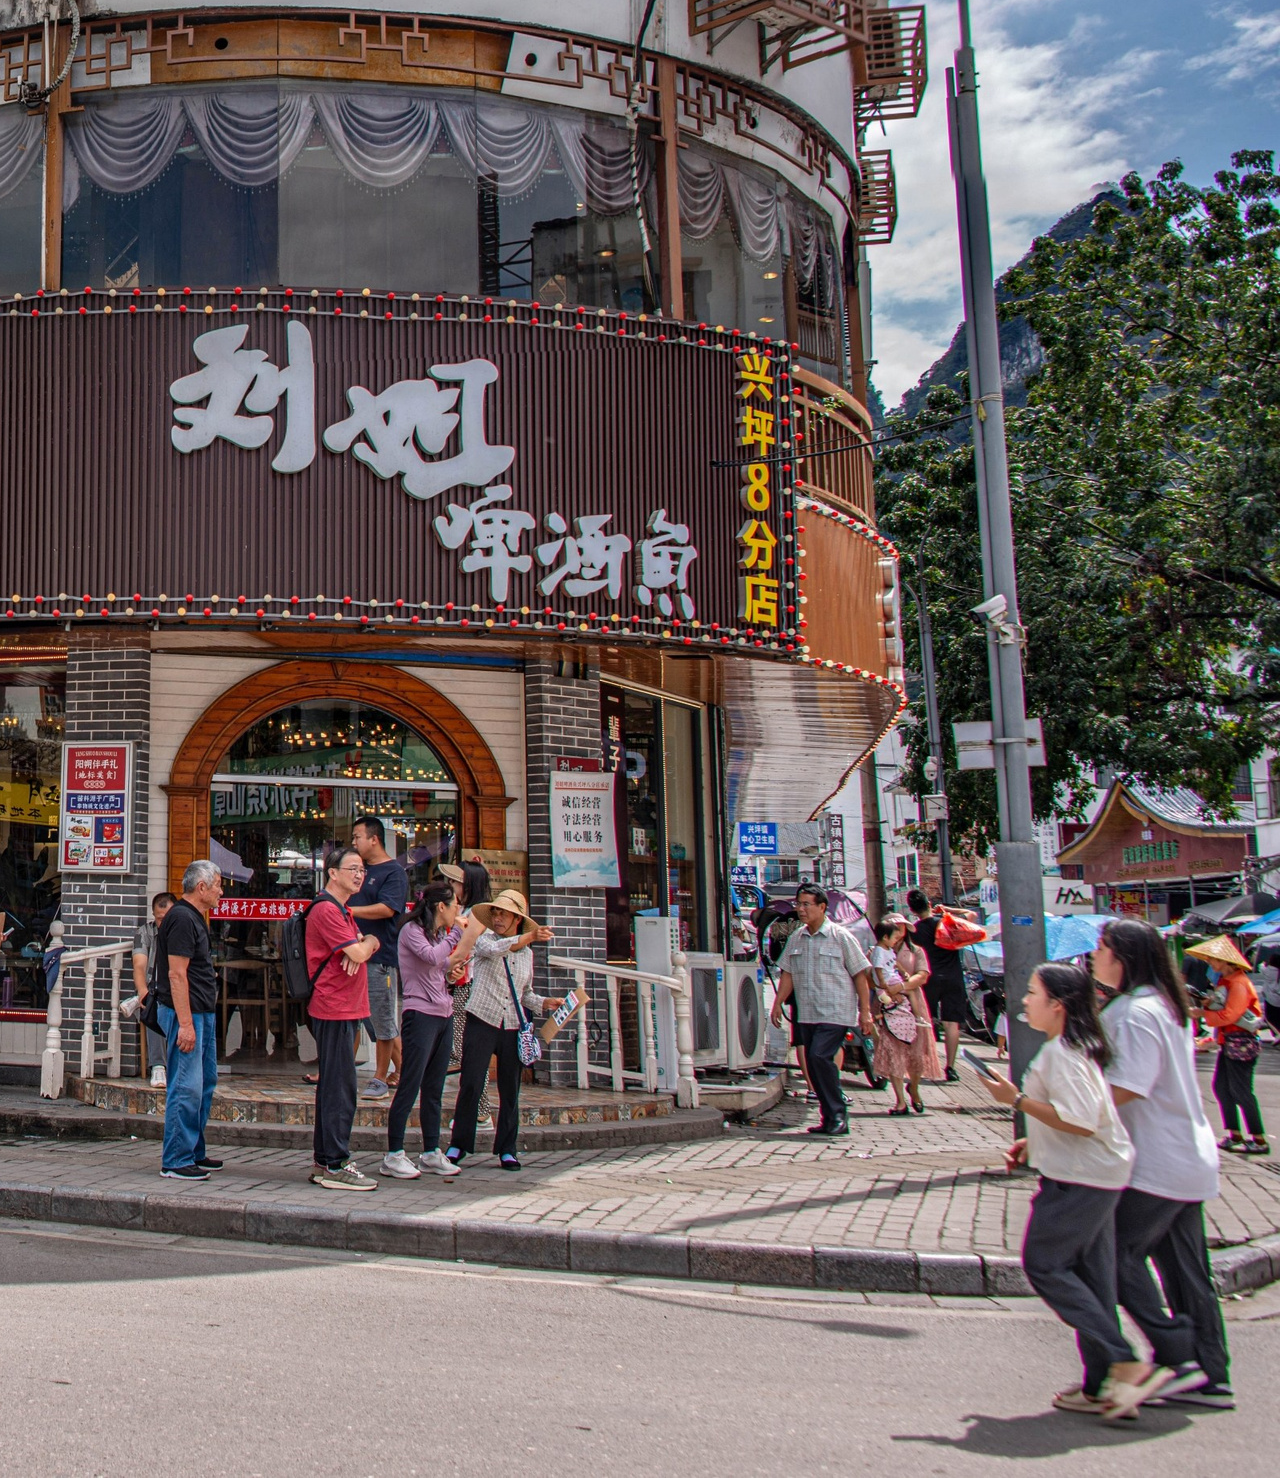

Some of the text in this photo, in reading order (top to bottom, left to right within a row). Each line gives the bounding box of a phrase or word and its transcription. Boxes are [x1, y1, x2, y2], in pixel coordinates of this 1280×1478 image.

[735, 351, 779, 629] 兴坪8分店
[433, 482, 698, 621] 啤酒鱼
[75, 759, 118, 770] 阳朔伴手礼
[562, 813, 602, 827] 守法经营
[747, 825, 768, 834] 兴坪镇
[563, 830, 603, 844] 用心服务
[741, 835, 775, 845] 中心卫生院
